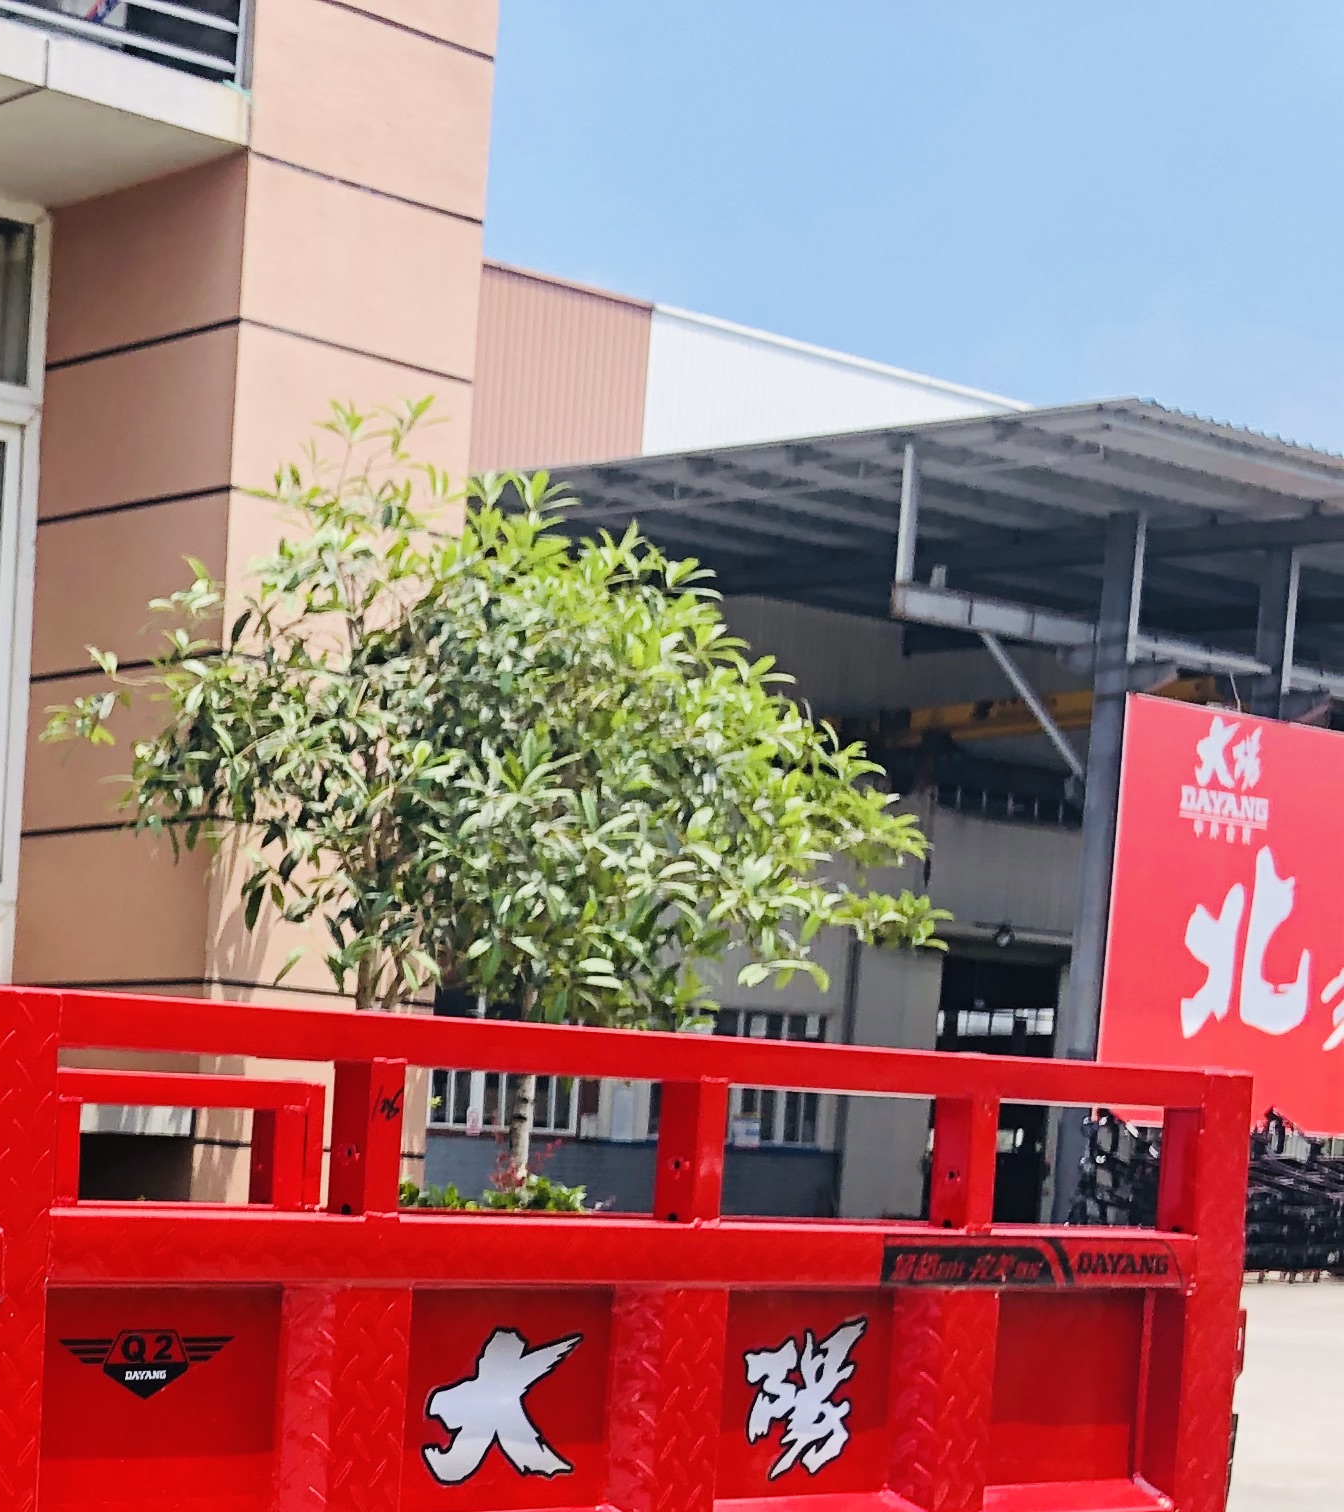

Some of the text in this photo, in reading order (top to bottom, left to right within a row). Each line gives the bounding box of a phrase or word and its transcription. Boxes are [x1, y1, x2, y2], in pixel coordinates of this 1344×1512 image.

[1180, 784, 1269, 822] DAYANG
[1077, 1252, 1169, 1275] DAYANG
[125, 1370, 167, 1381] DAYANG
